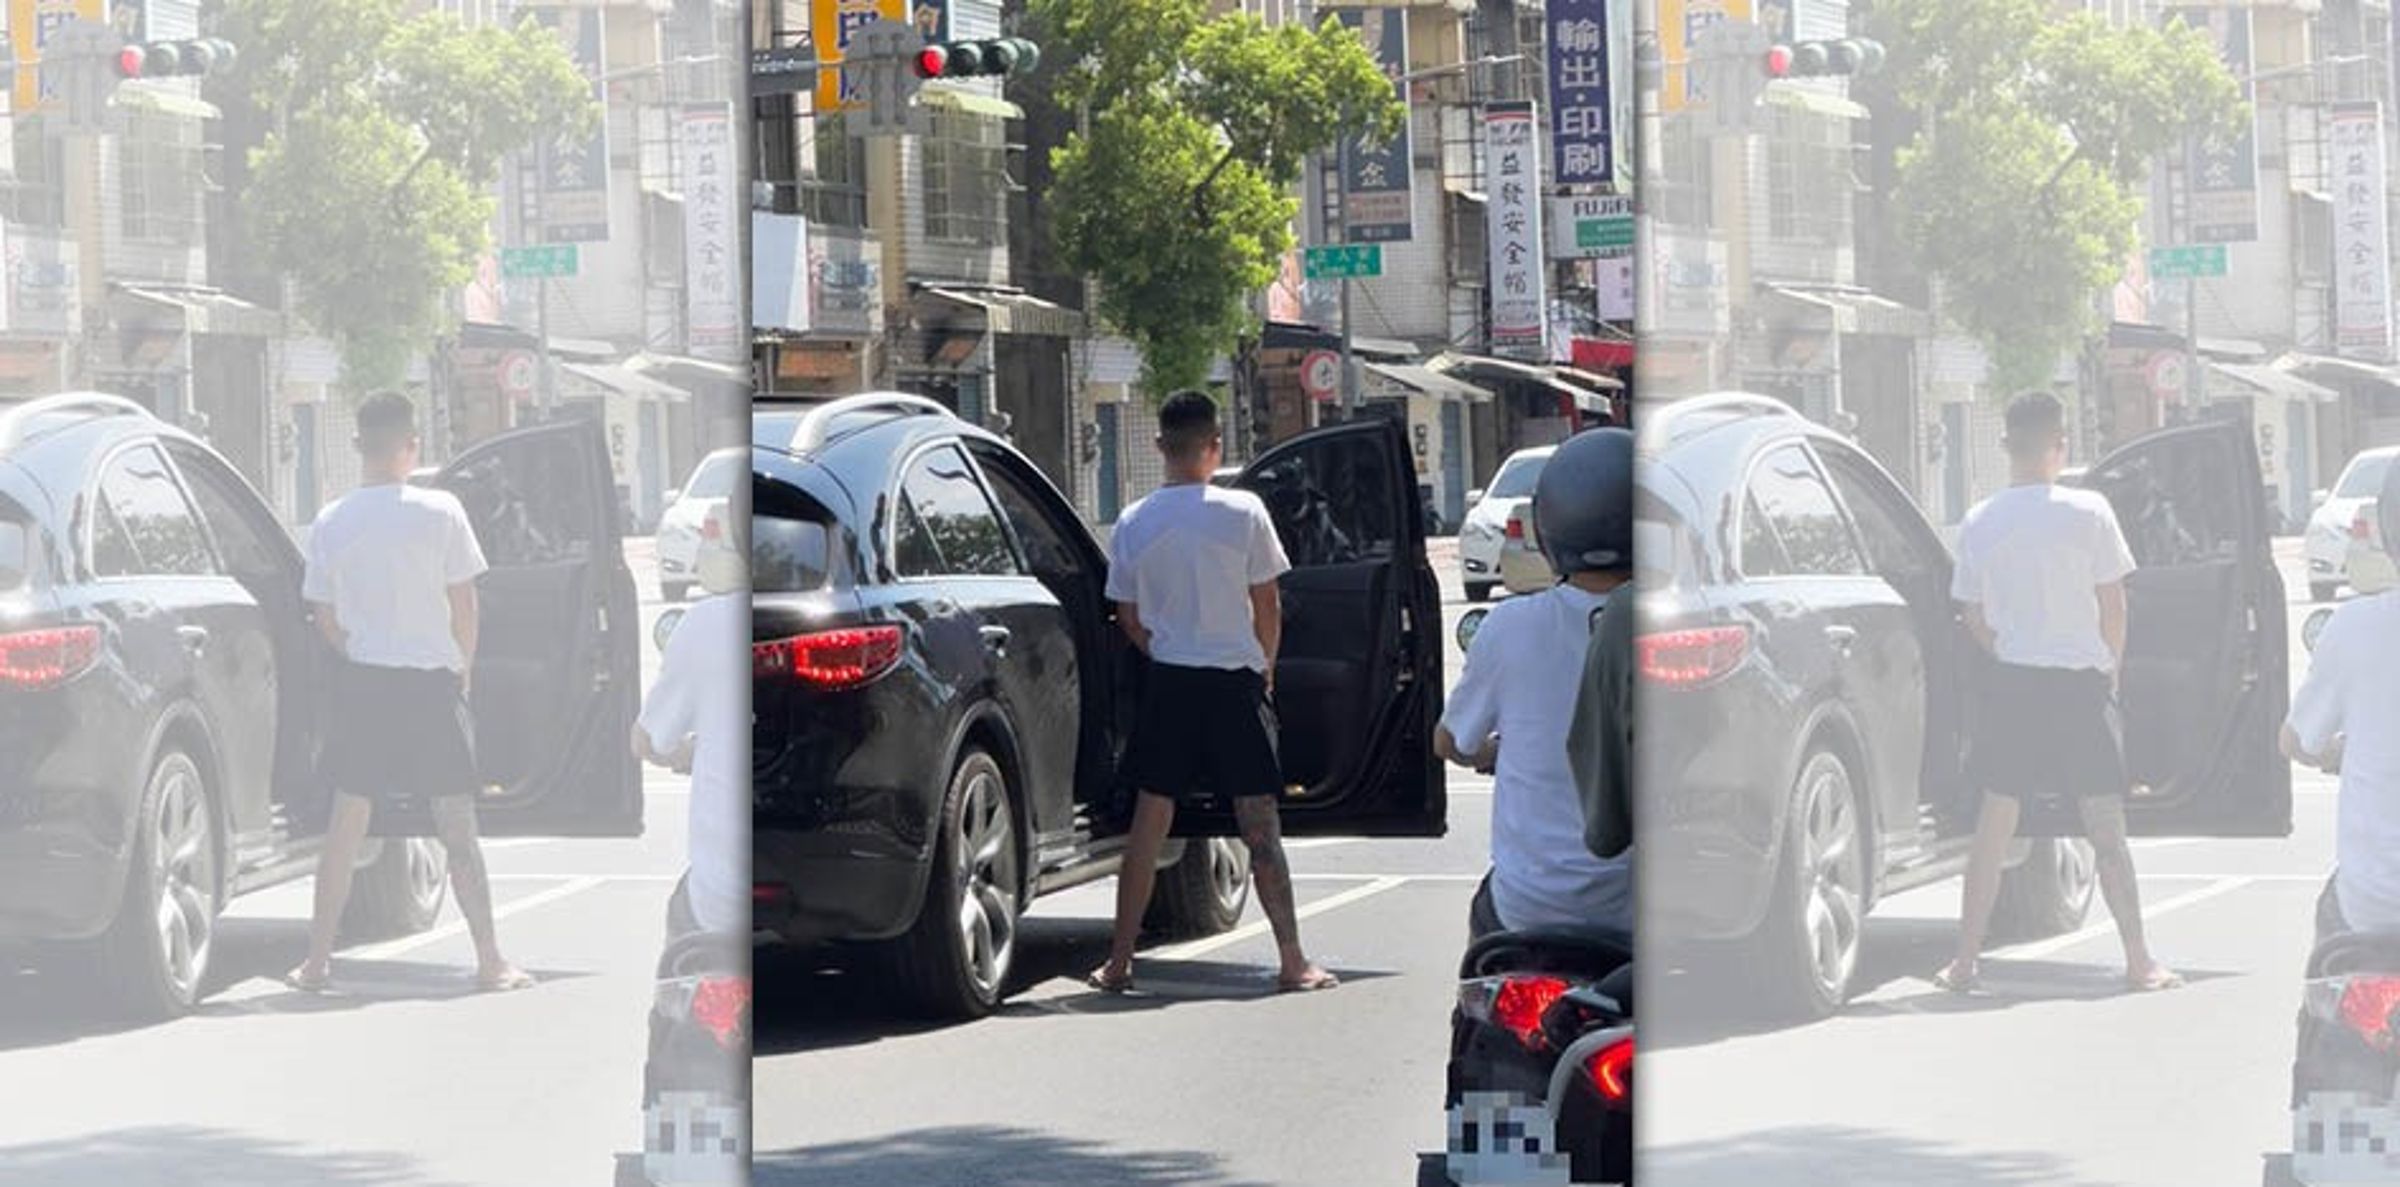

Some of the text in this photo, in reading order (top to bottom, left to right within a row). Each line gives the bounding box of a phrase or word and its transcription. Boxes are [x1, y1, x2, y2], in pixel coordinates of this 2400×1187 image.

[1500, 150, 1527, 294] 益發安全帽
